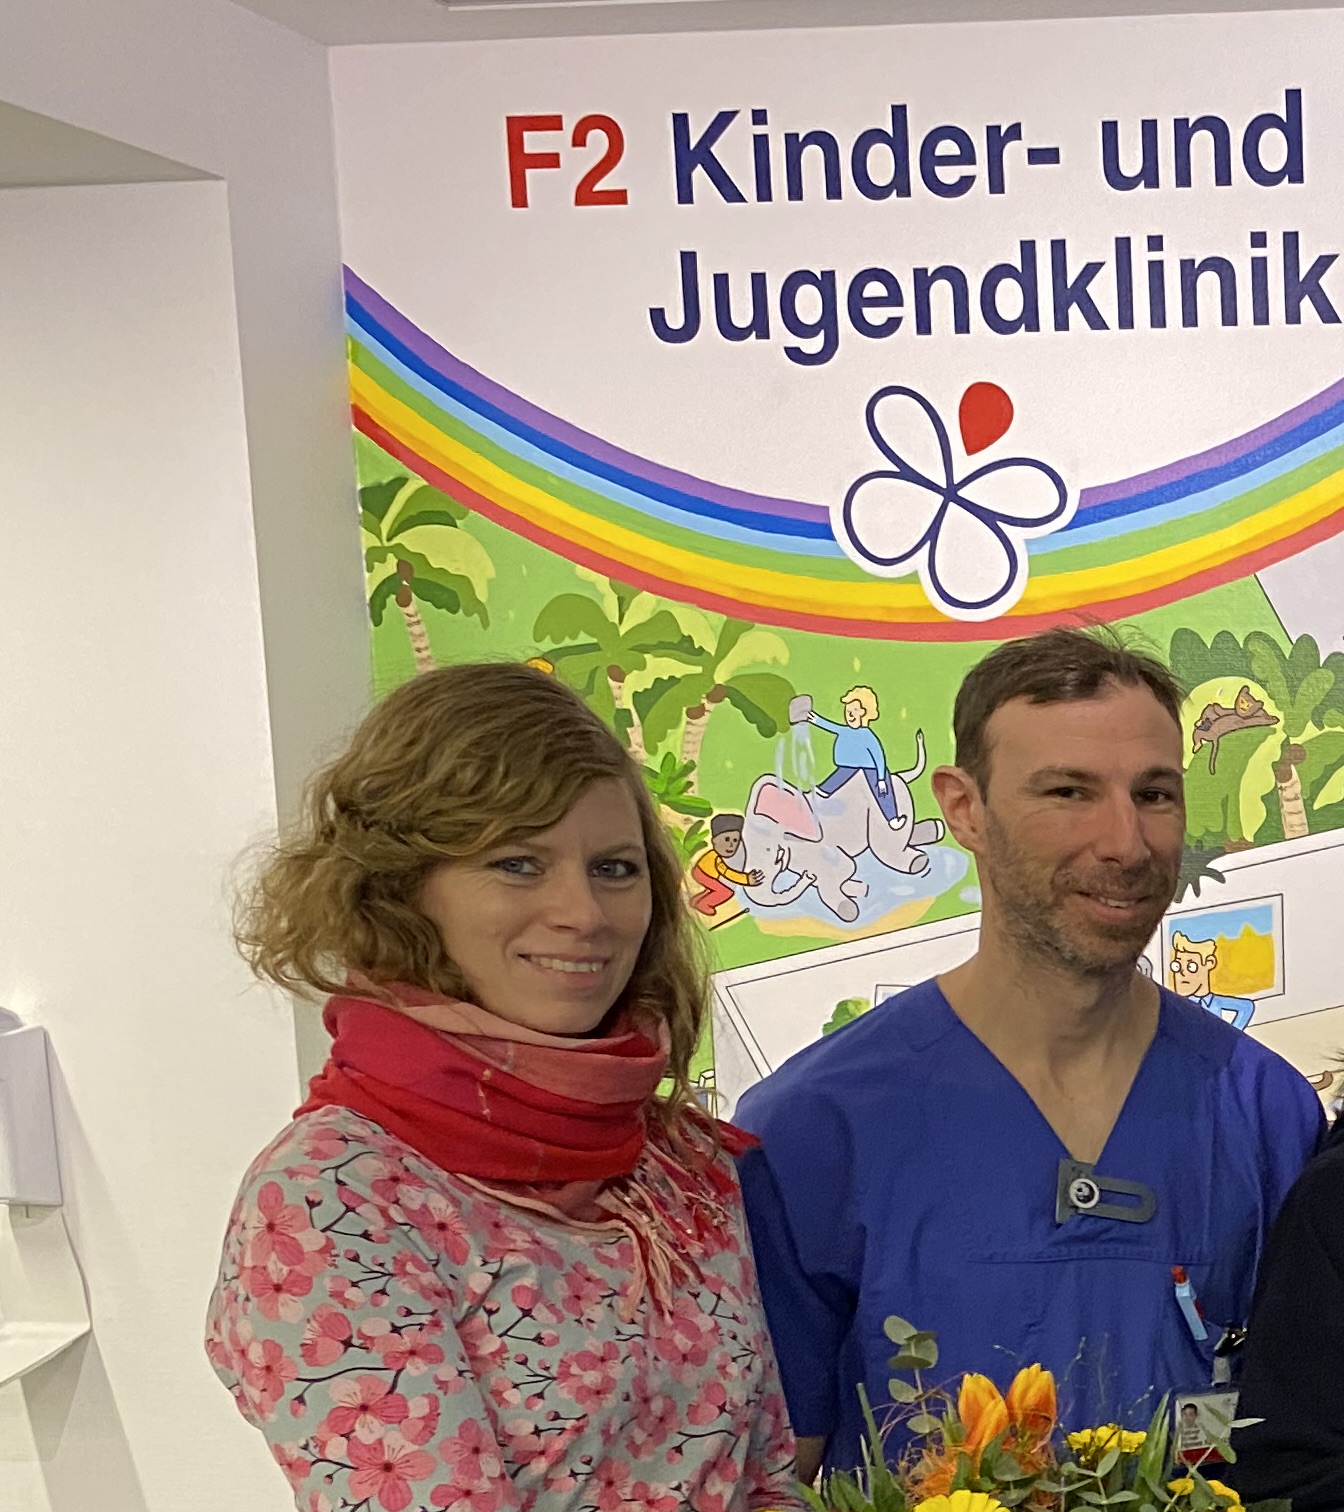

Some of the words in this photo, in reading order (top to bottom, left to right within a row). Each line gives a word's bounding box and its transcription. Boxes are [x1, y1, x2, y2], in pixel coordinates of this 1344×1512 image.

[504, 113, 630, 209] F2
[670, 103, 1061, 206] Kinder-
[1100, 87, 1305, 193] und
[648, 229, 1343, 367] Jugendklinik
